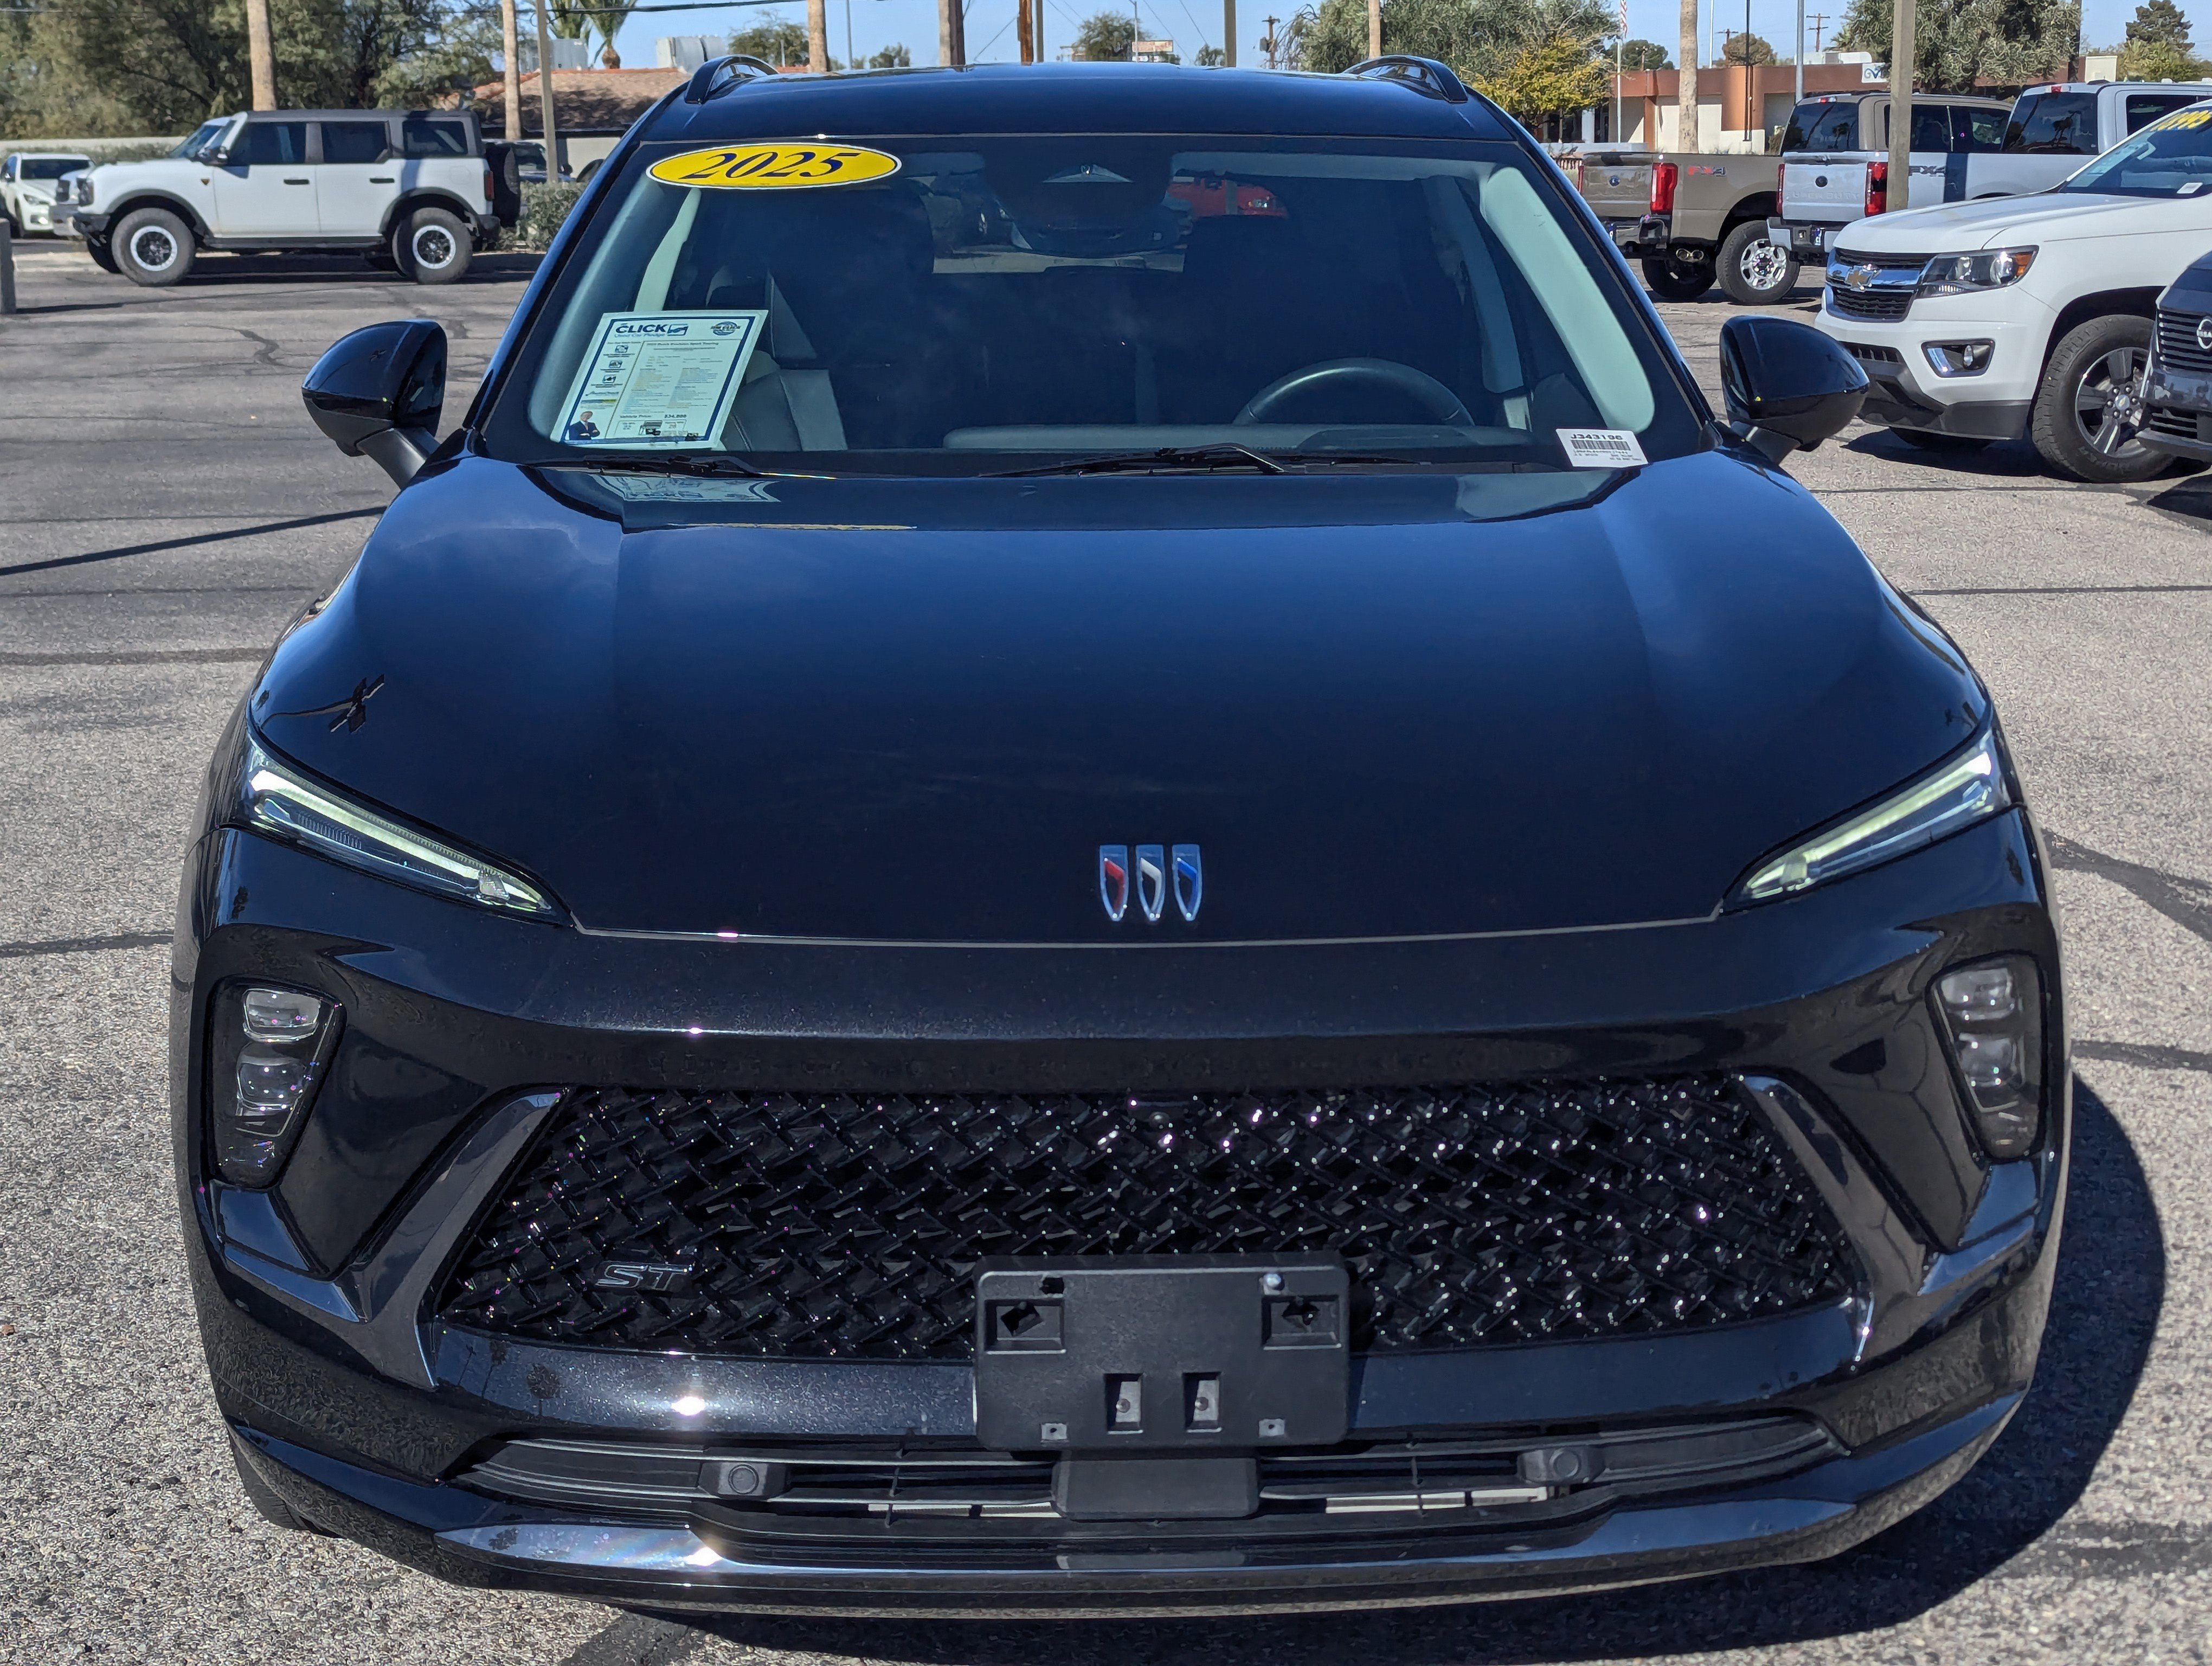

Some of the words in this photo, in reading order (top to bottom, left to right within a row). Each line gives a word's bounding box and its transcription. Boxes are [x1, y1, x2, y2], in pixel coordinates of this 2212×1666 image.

[679, 151, 862, 180] 2025
[615, 324, 668, 333] CLICK
[595, 1264, 692, 1291] ST
